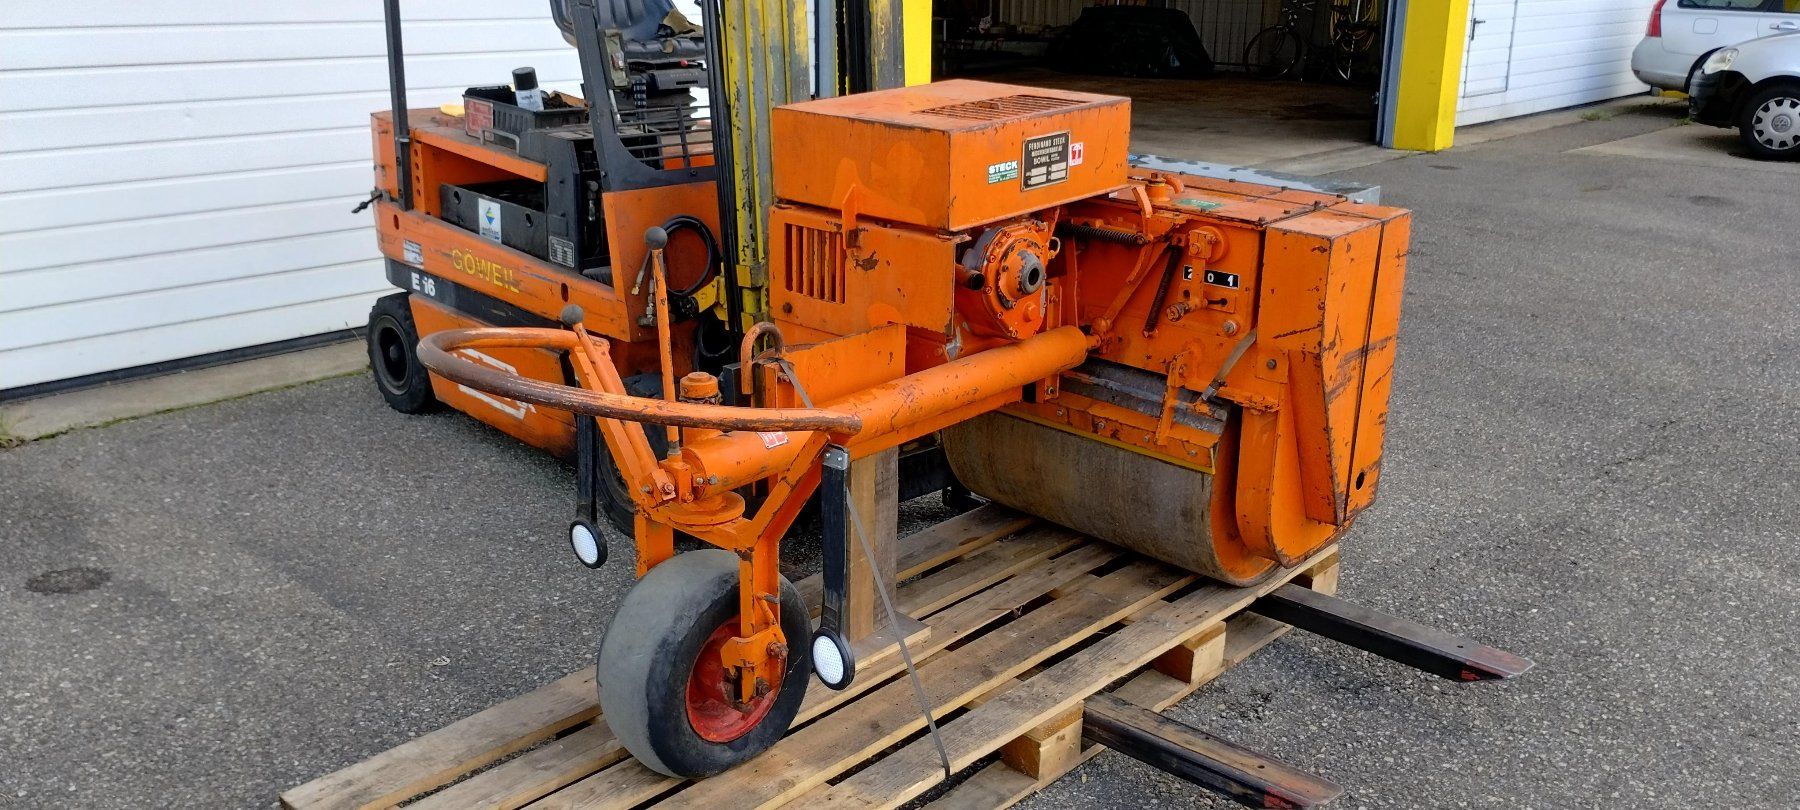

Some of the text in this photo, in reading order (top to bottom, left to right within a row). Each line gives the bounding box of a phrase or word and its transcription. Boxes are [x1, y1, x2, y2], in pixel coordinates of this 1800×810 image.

[988, 160, 1018, 174] STECK
[452, 248, 519, 293] GÖWEIL
[411, 271, 421, 291] E
